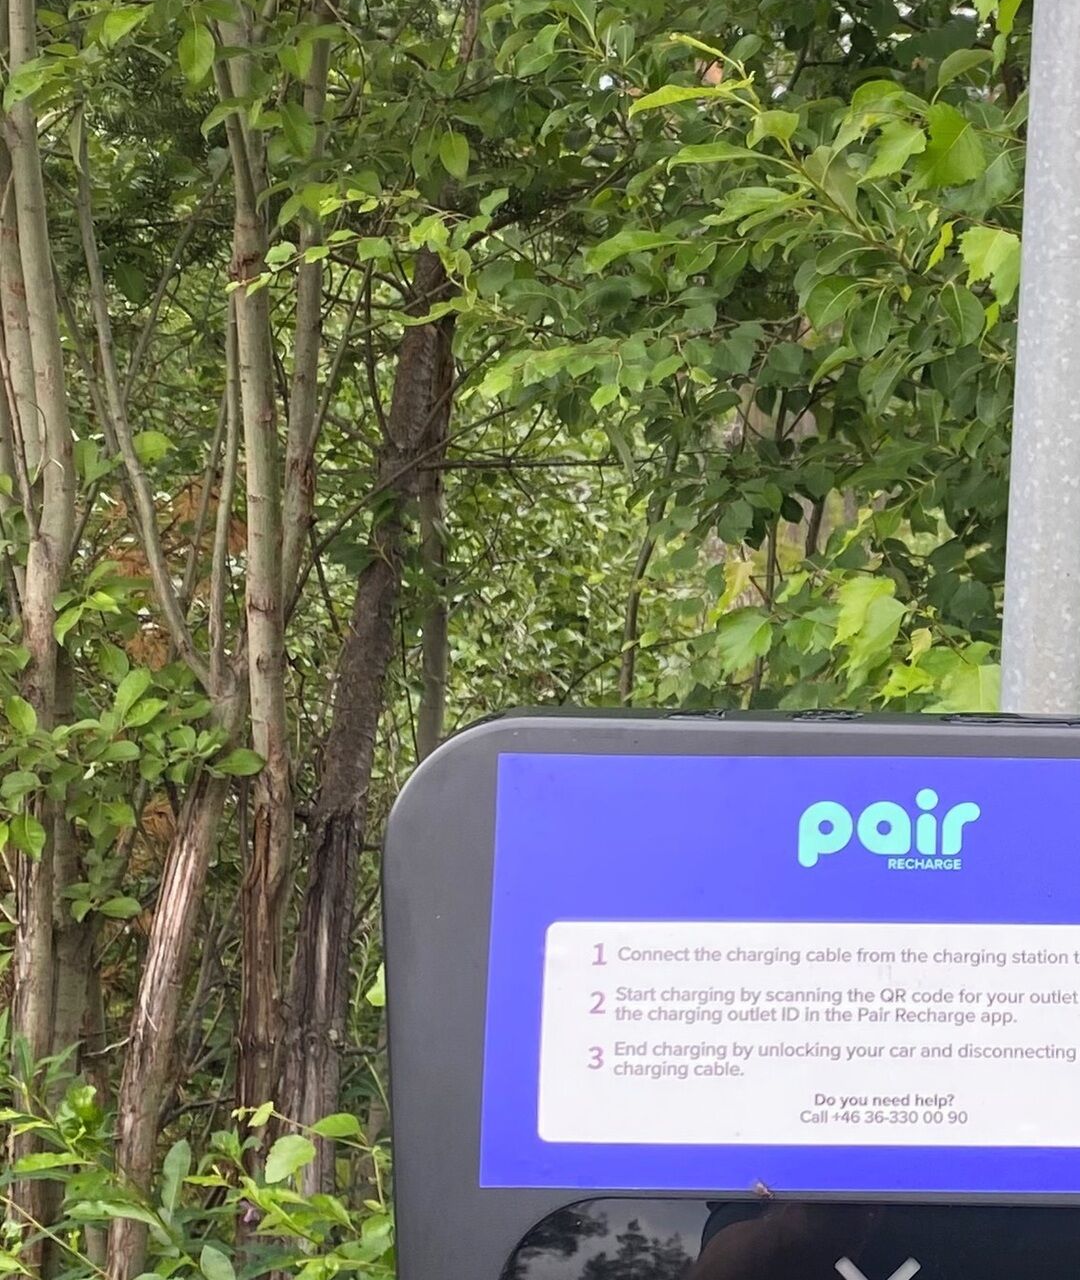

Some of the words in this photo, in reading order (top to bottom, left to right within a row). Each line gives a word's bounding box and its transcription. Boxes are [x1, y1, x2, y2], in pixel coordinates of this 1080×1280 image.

[797, 788, 981, 868] pair
[887, 858, 962, 870] RECHARGE
[591, 942, 608, 967] 1
[617, 946, 691, 962] Connect
[693, 946, 722, 962] the
[725, 946, 801, 966] charging
[805, 947, 853, 963] cable
[856, 947, 896, 963] from
[900, 947, 929, 964] the
[932, 948, 1007, 968] charging
[1011, 948, 1069, 965] station
[588, 990, 607, 1015] 2
[615, 986, 657, 1002] Start
[660, 986, 736, 1006] charging
[740, 986, 762, 1006] by
[765, 987, 843, 1007] scanning
[846, 987, 876, 1004] the
[879, 987, 907, 1004] QR
[911, 988, 955, 1004] code
[958, 988, 983, 1004] for
[986, 991, 1026, 1008] your
[1029, 989, 1079, 1005] outlet
[614, 1005, 644, 1021] the
[646, 1006, 723, 1025] charging
[726, 1006, 778, 1022] outlet
[781, 1006, 801, 1022] ID
[804, 1006, 820, 1022] in
[824, 1006, 853, 1023] the
[857, 1006, 891, 1023] Pair
[894, 1007, 977, 1027] Recharge
[980, 1011, 1018, 1027] app.
[586, 1045, 605, 1071] 3
[614, 1040, 648, 1057] End
[651, 1041, 728, 1061] charging
[732, 1041, 755, 1061] by
[757, 1041, 842, 1062] unlocking
[845, 1045, 886, 1062] your
[888, 1046, 917, 1058] car
[920, 1043, 953, 1059] and
[957, 1042, 1077, 1063] disconnecting
[613, 1060, 689, 1080] charging
[693, 1061, 745, 1077] cable.
[813, 1092, 837, 1107] Do
[839, 1095, 869, 1110] you
[871, 1093, 911, 1108] need
[914, 1093, 956, 1110] help?
[799, 1109, 829, 1124] Call
[831, 1110, 861, 1124] +46
[863, 1110, 919, 1125] 36-330
[922, 1110, 944, 1125] 00
[947, 1110, 969, 1125] 90
